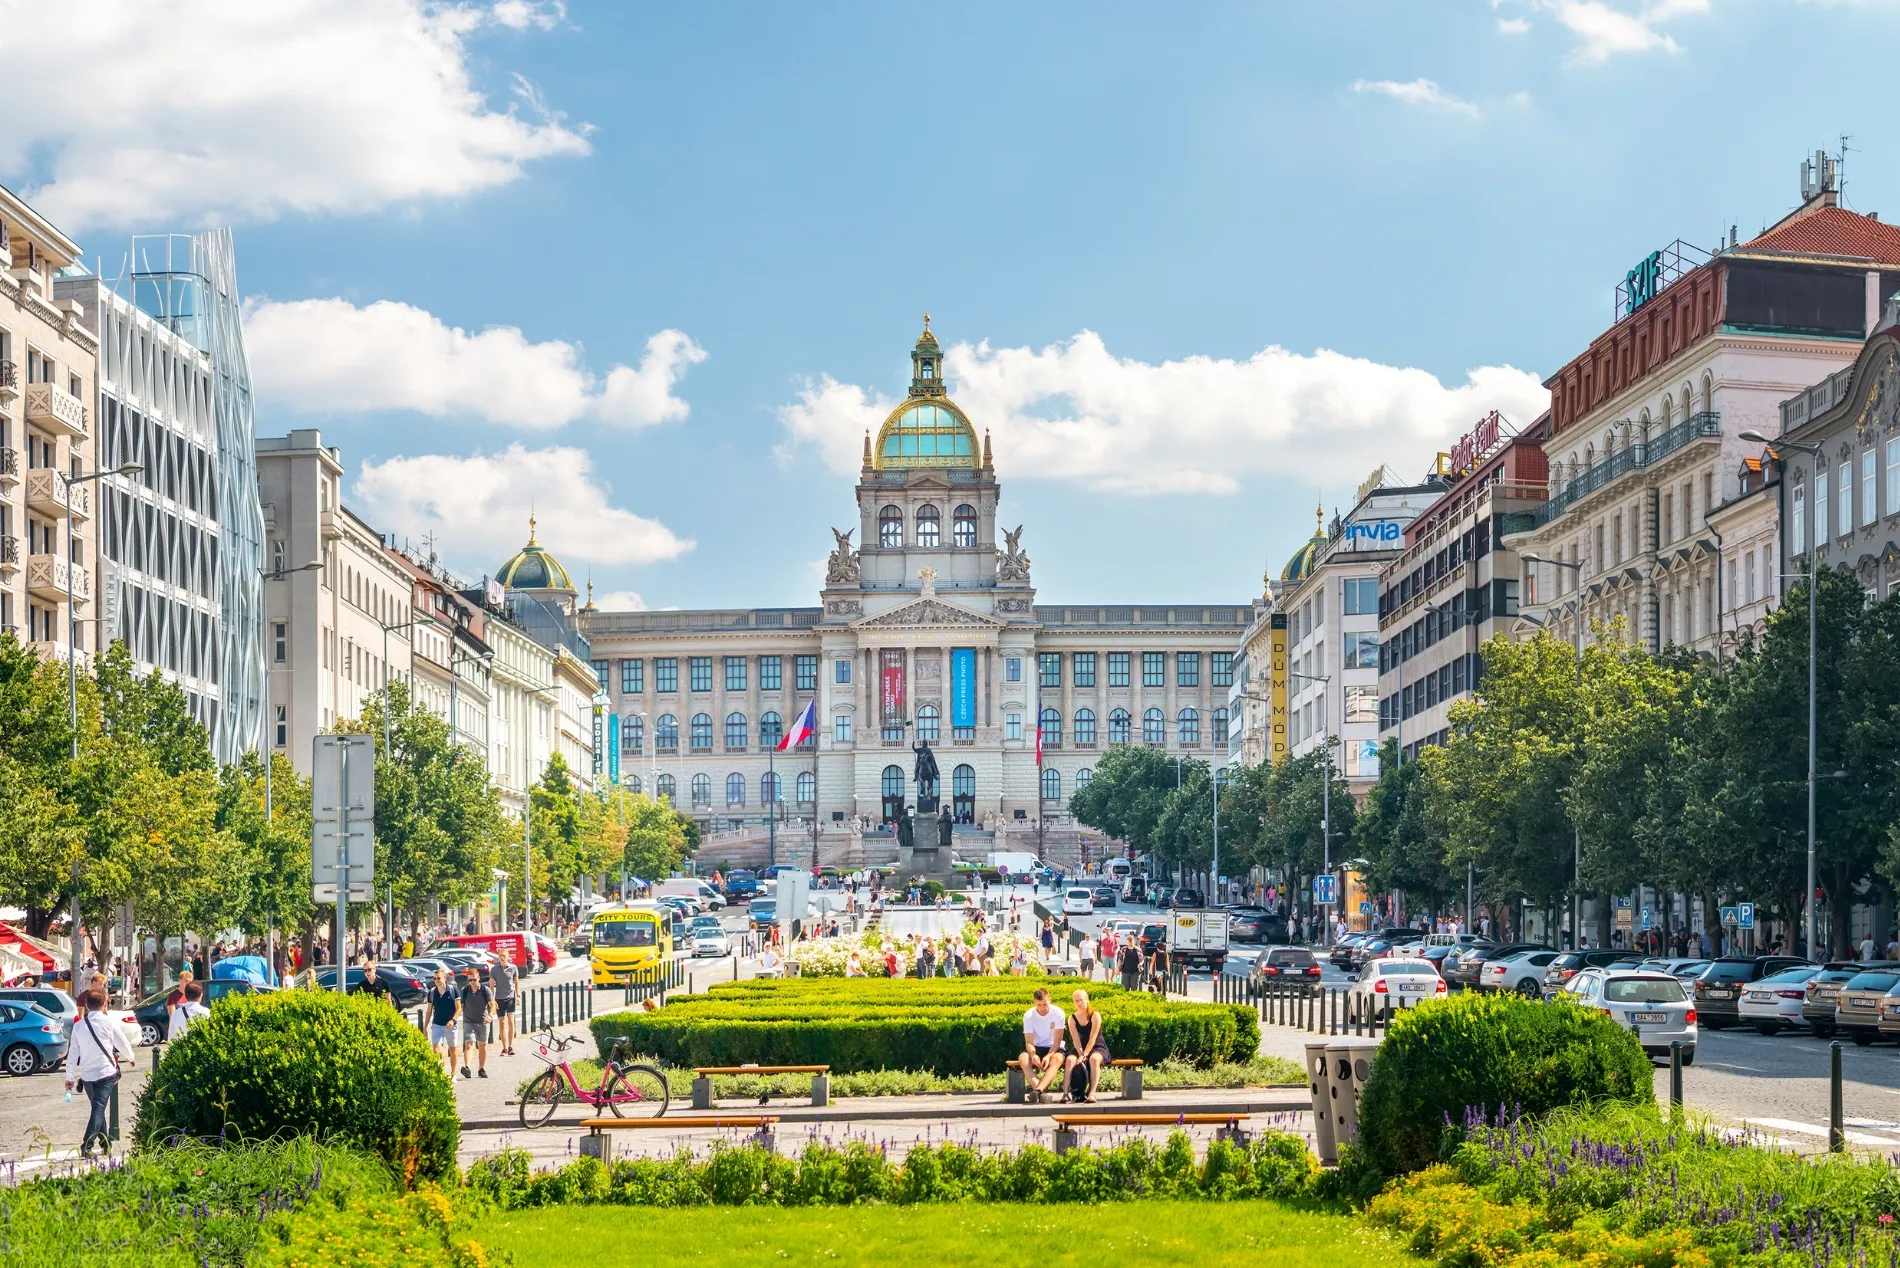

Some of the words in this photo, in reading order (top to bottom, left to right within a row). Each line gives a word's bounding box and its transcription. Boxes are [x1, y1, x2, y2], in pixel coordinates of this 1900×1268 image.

[1626, 251, 1660, 313] SZIF
[1345, 517, 1400, 541] invia
[105, 573, 115, 634] PRIMARK
[1643, 910, 1648, 923] P
[1742, 906, 1750, 921] P
